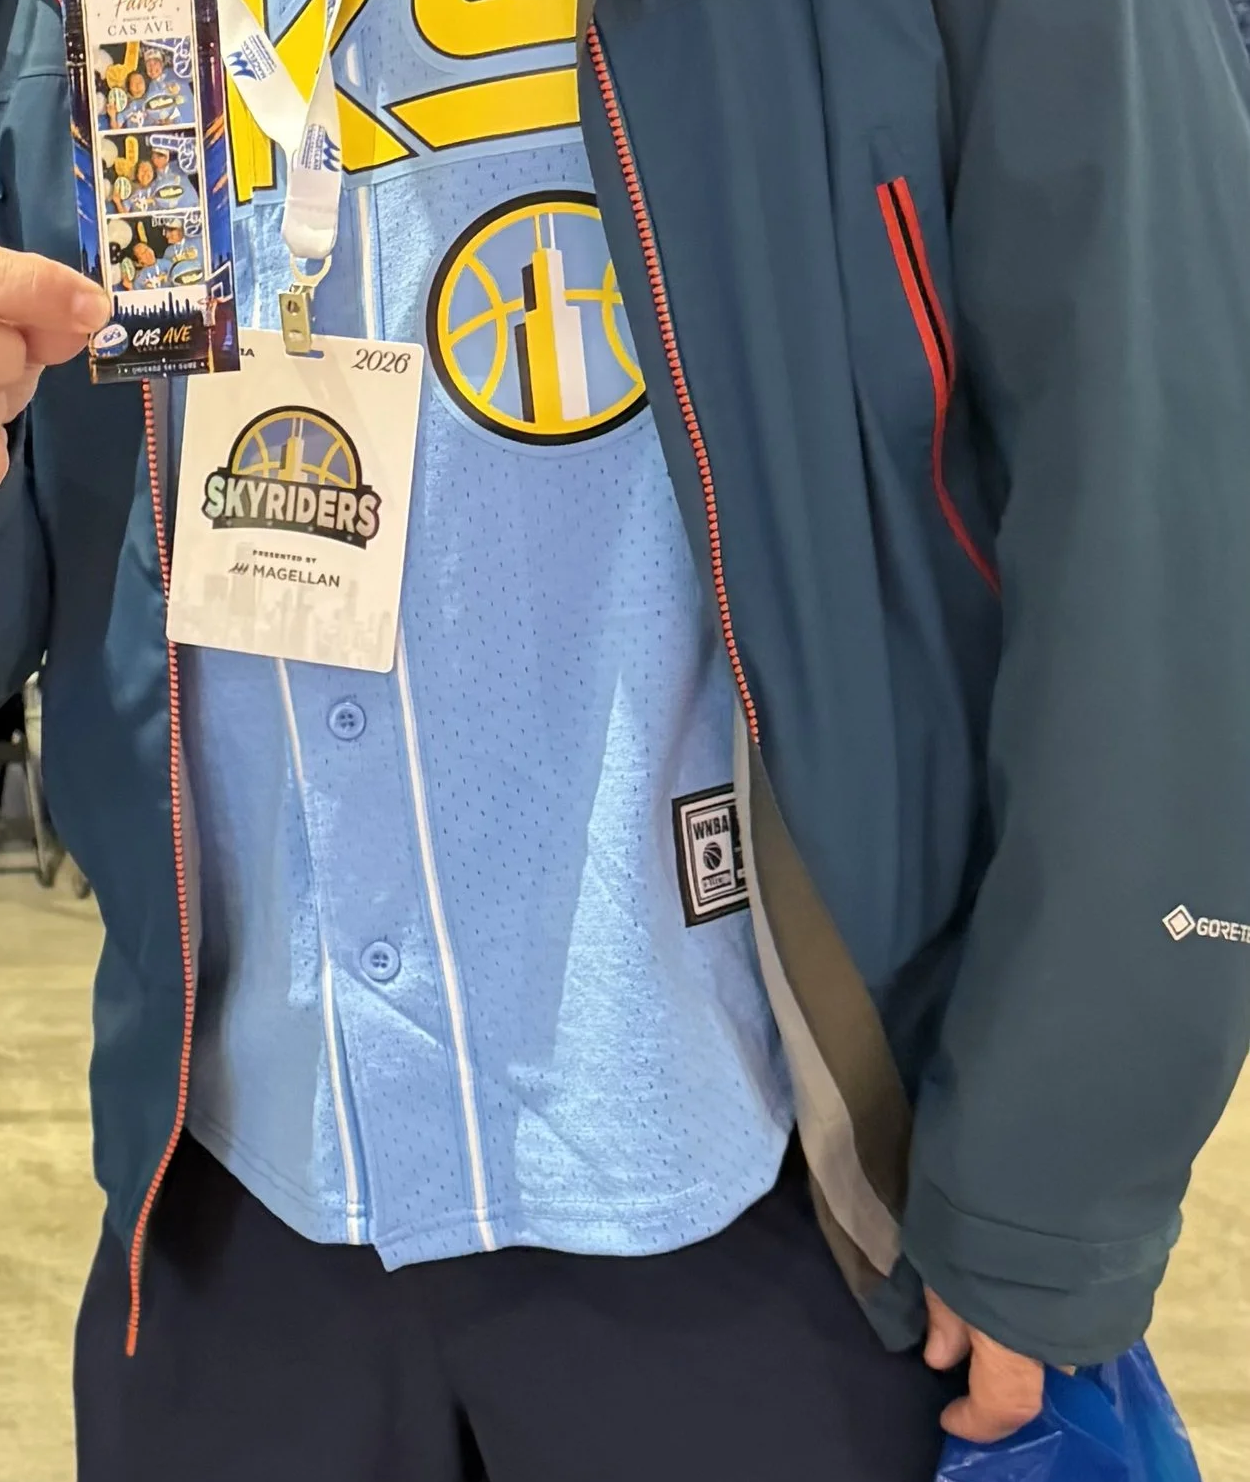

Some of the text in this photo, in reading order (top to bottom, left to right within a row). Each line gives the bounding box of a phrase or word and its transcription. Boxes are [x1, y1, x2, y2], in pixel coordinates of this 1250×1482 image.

[108, 21, 173, 36] CAS AVE
[132, 324, 192, 347] CAS AVE
[351, 348, 412, 374] 2026
[205, 475, 382, 539] SKYRIDERS
[253, 549, 317, 564] PRESENTED BY
[253, 564, 340, 587] MAGELLAN
[693, 815, 729, 840] WNBA
